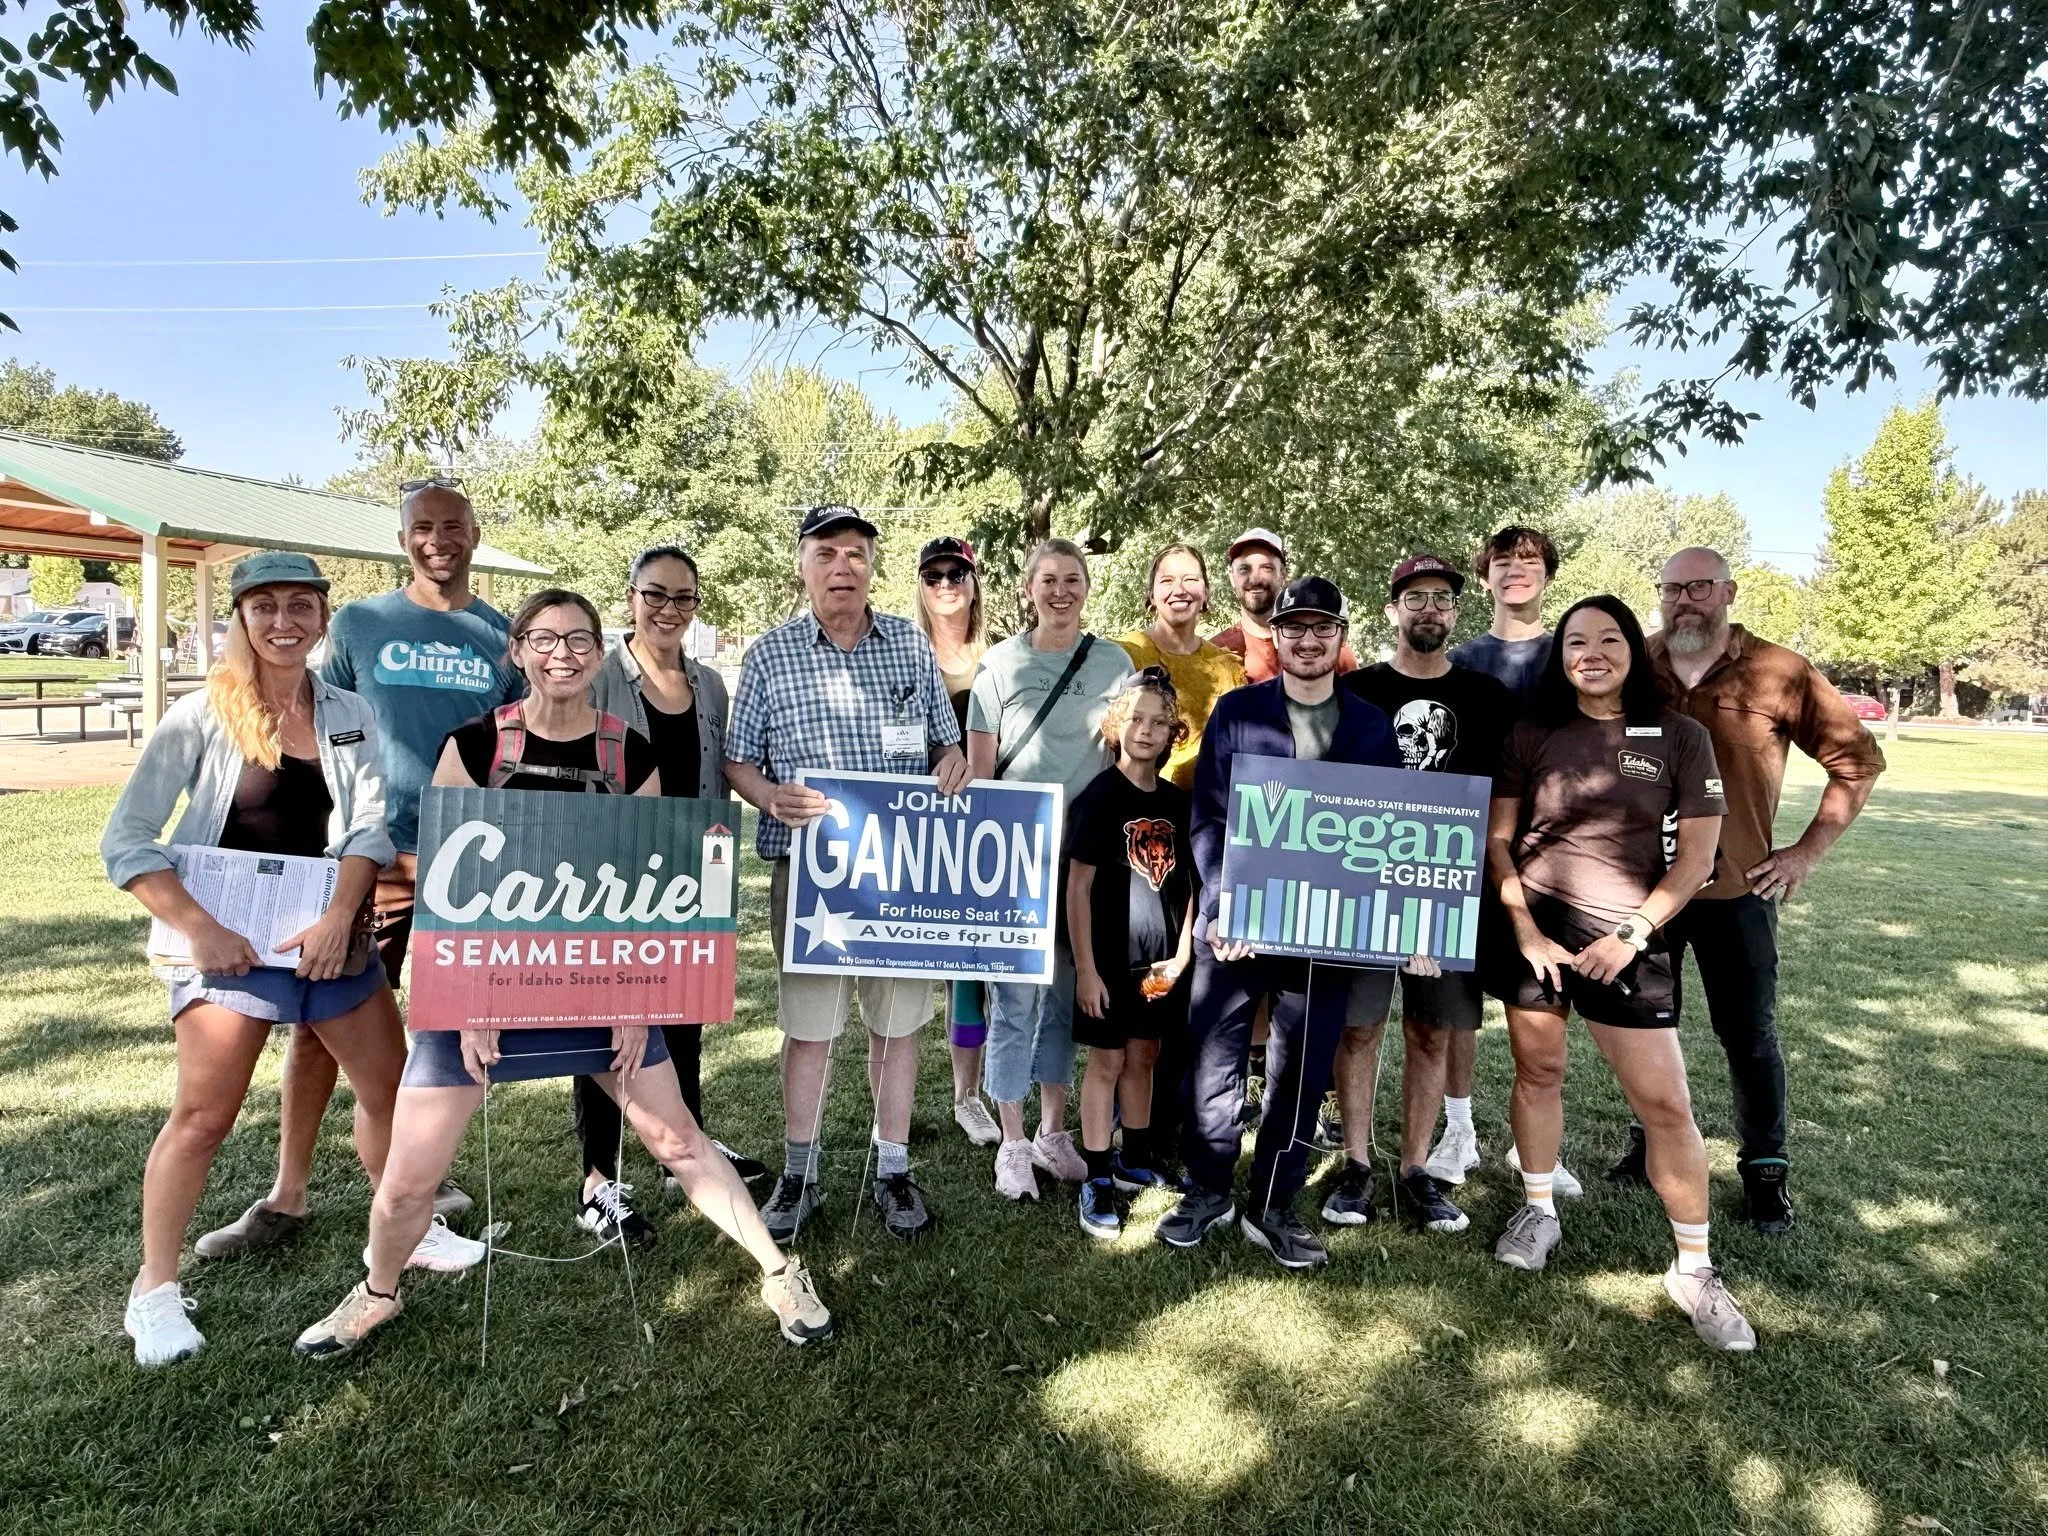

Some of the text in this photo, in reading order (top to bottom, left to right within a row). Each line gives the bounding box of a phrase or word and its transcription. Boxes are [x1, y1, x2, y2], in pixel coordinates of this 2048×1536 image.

[381, 642, 490, 679] Church
[436, 674, 489, 689] for Idaho
[888, 790, 972, 814] JOHN
[1313, 794, 1480, 818] YOUR IDAHO STATE REPRESENTATIVE
[1230, 783, 1477, 873] Megan
[805, 798, 1045, 899] GANNON
[423, 820, 702, 923] Carrie
[1380, 863, 1476, 891] EGBERT
[879, 903, 1039, 924] For House Seat 17-A
[859, 925, 1037, 944] A Voice for Us!
[435, 939, 715, 966] SEMMELROTH
[489, 972, 668, 986] for Idaho State Senate
